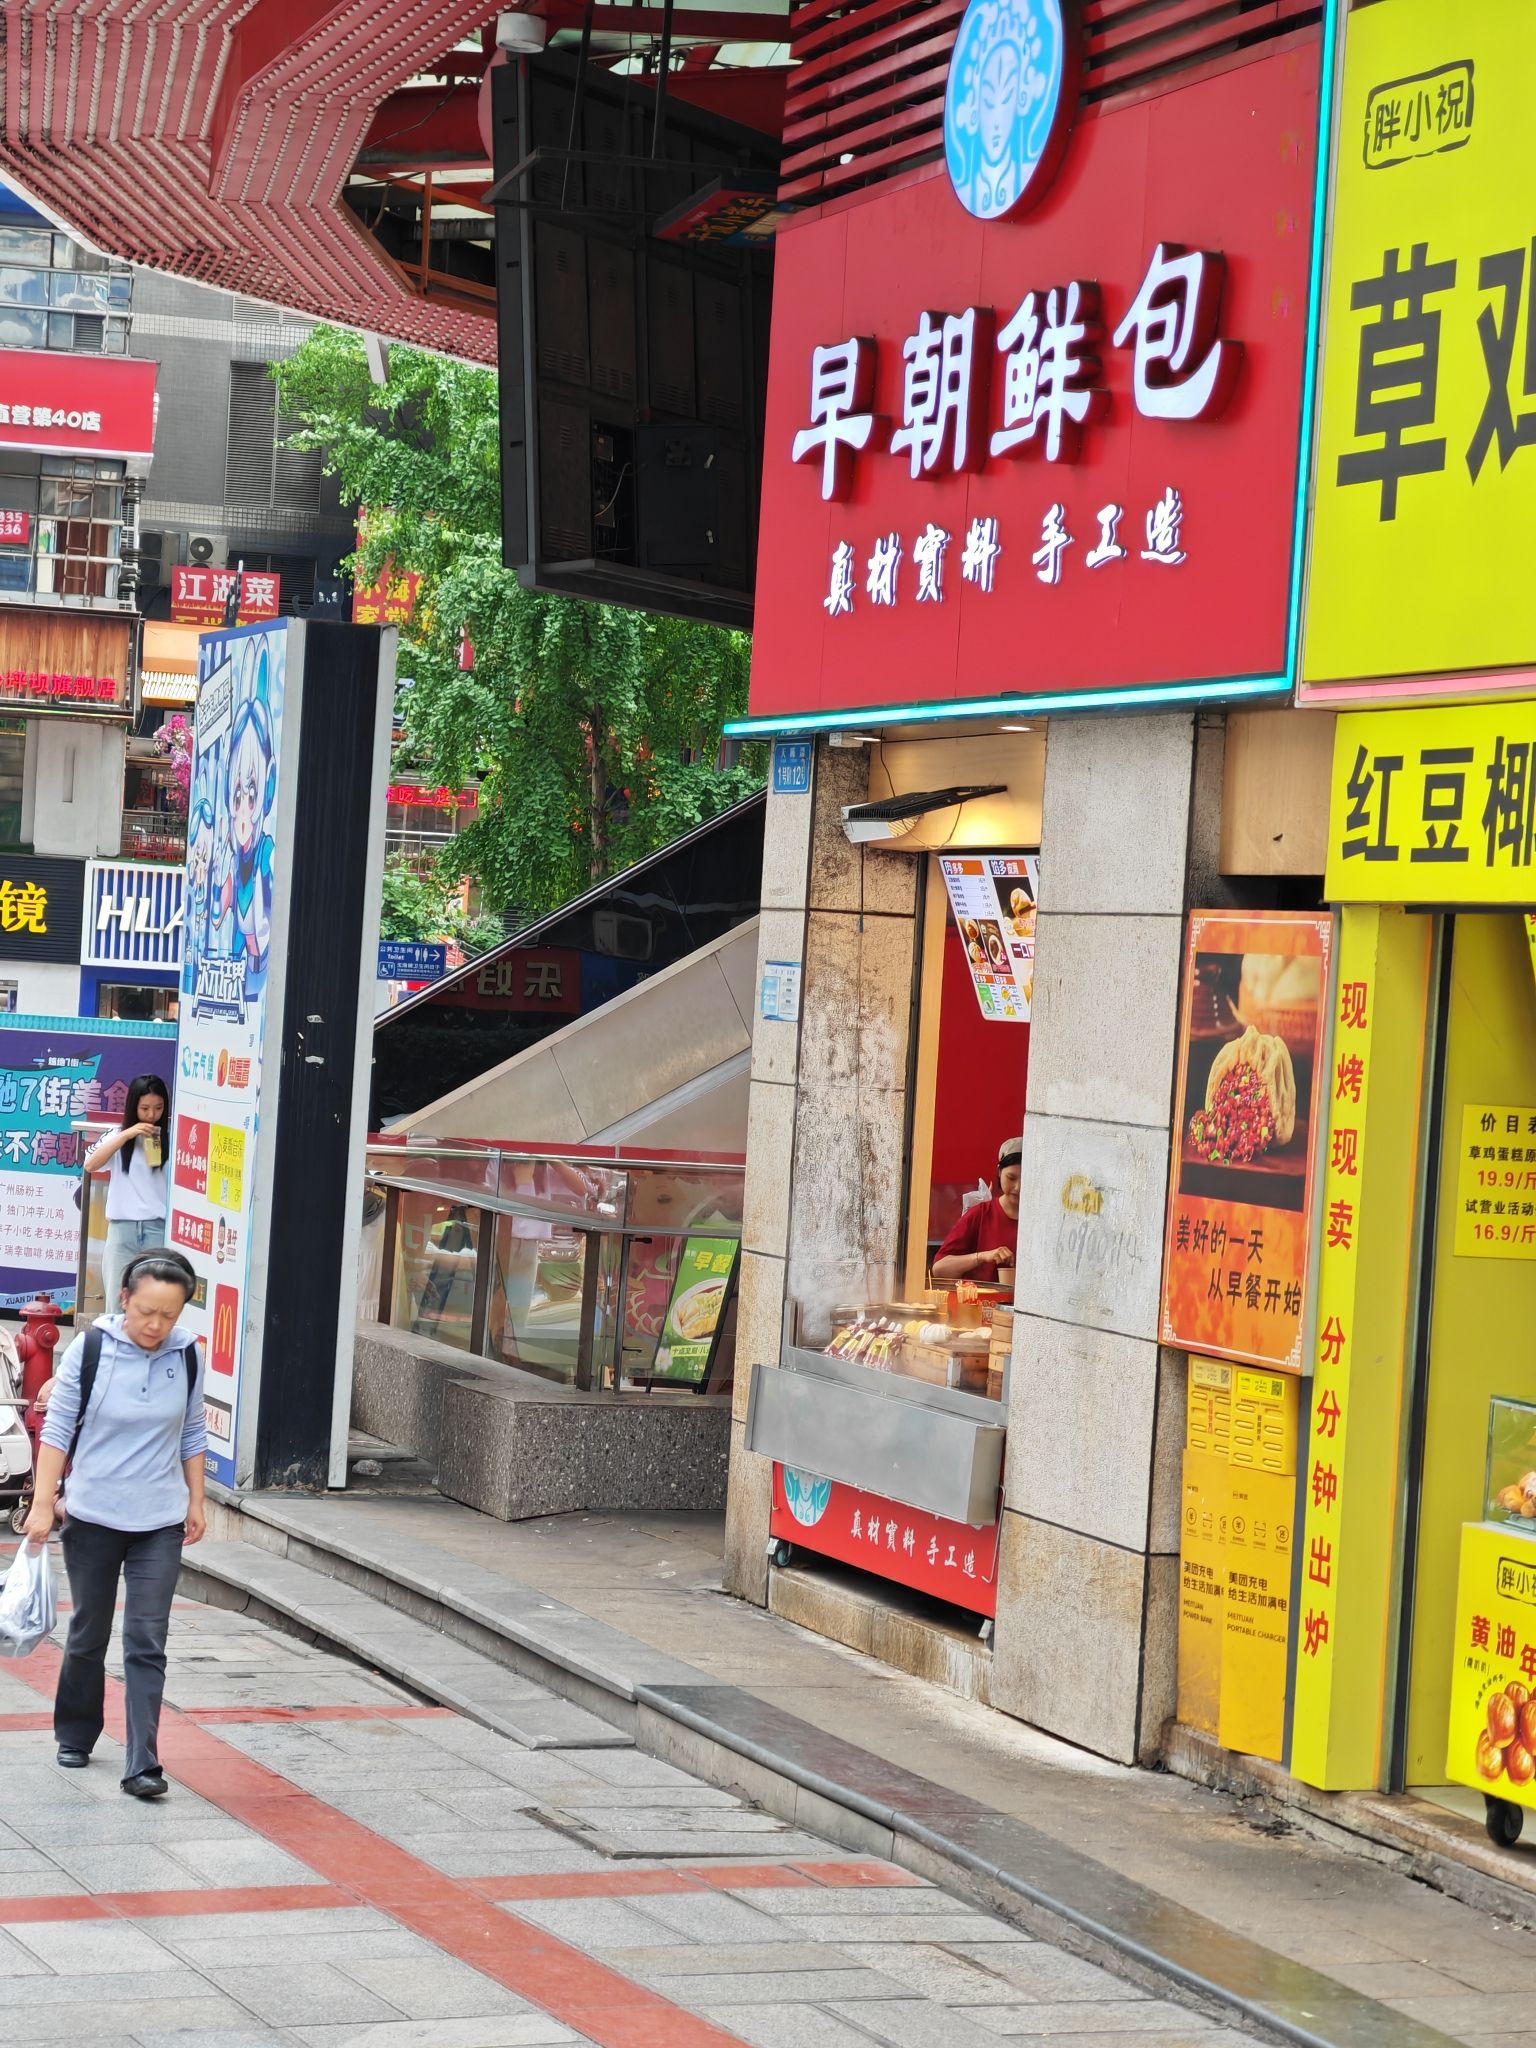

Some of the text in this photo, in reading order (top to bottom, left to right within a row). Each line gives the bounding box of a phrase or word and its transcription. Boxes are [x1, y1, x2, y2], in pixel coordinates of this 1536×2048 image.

[1373, 79, 1464, 153] 胖小祝
[792, 243, 1224, 501] 早朝鲜包
[1031, 487, 1188, 584] 手工造
[178, 571, 276, 608] 江湖菜
[0, 671, 117, 699] 坪坝旗舰店
[1177, 1212, 1264, 1264] 美好的一天
[693, 1251, 733, 1274] 早餐
[1207, 1267, 1302, 1317] 从早餐开始
[1302, 981, 1369, 1658] 现烤现卖 分分钟出炉
[1228, 1587, 1287, 1612] 给生活加满电
[1229, 1571, 1268, 1592] 美团充电
[1227, 1612, 1254, 1624] MEITUAN
[1227, 1623, 1286, 1643] PORTABLE CHARGER
